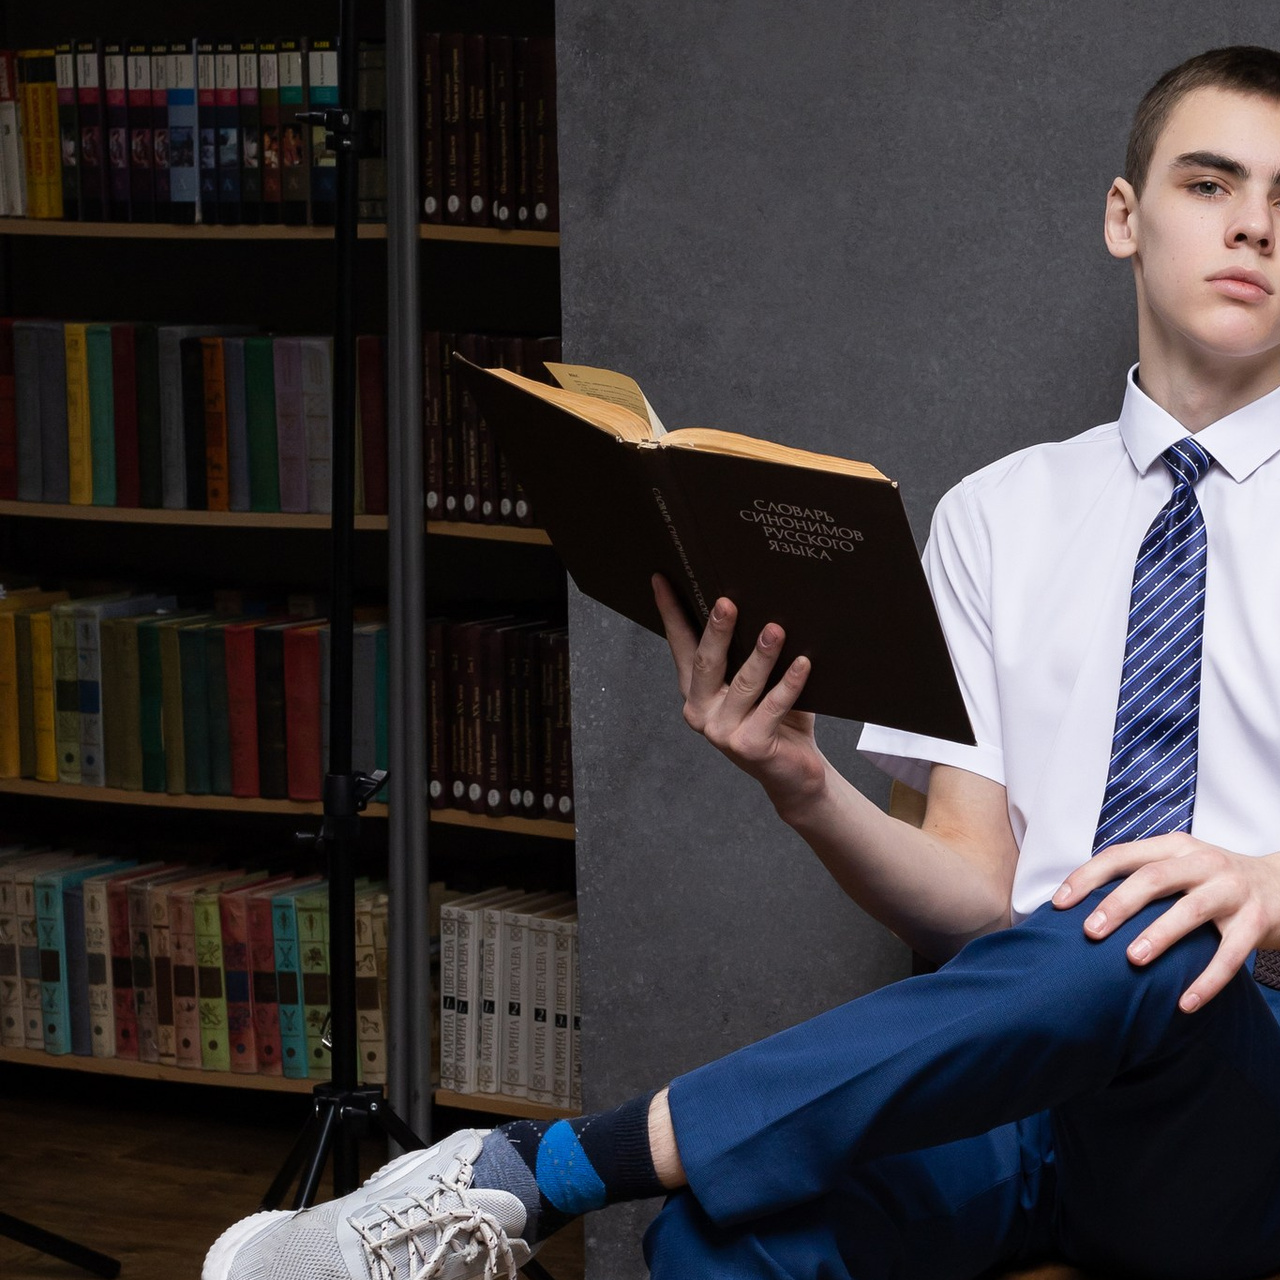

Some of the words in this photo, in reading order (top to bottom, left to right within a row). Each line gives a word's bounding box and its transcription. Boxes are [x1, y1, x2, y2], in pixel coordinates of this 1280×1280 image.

[754, 499, 834, 522] СЛОВАРЬ
[740, 510, 864, 541] СИНОНИМОВ
[764, 526, 854, 552] РУССКОГО
[770, 540, 832, 561] ЯЗЫКА
[444, 939, 454, 993] ЦВЕТАЕВА
[443, 1014, 453, 1059] МАРИНА
